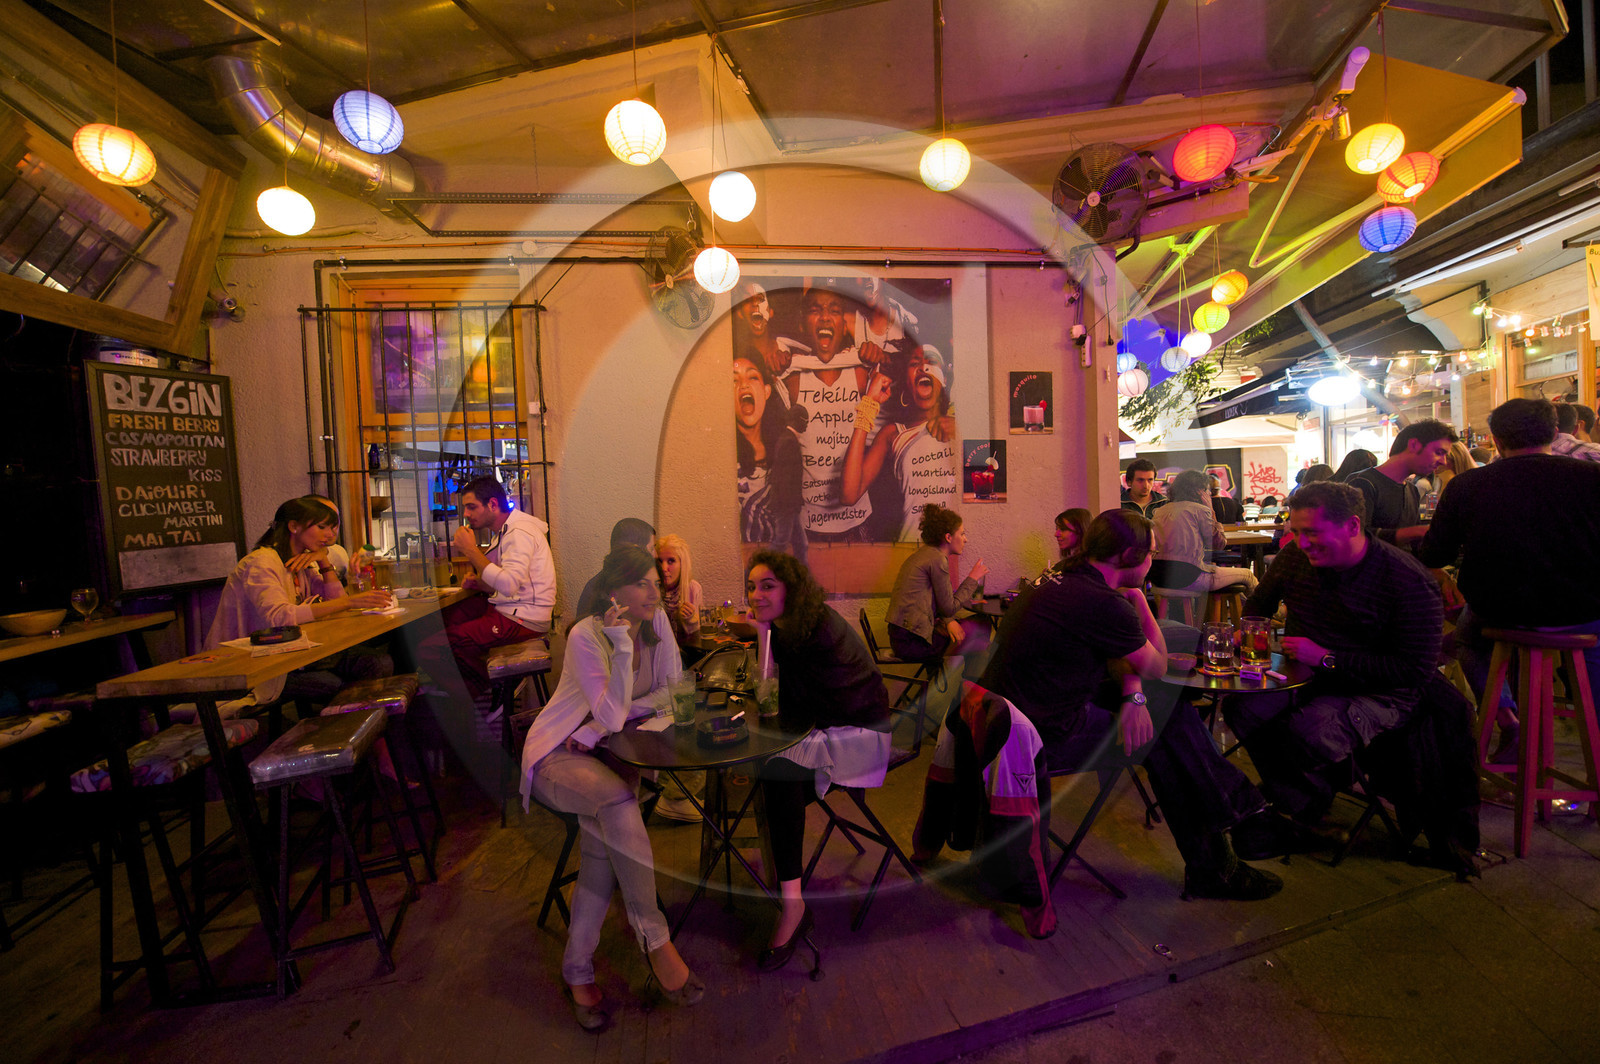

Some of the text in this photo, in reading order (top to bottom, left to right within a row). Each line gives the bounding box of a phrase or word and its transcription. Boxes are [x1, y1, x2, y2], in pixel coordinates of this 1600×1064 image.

[799, 387, 859, 404] Tekila
[108, 413, 220, 433] FRESH BERRY
[810, 409, 854, 429] Apple
[105, 432, 225, 449] COSMOPOLITAN
[816, 431, 850, 450] mojito
[110, 448, 207, 467] STRAWBERRY
[802, 454, 841, 467] Beer
[911, 447, 955, 465] coctail
[911, 467, 957, 478] martini
[806, 492, 832, 503] votk
[908, 484, 957, 498] longisland
[118, 500, 216, 517] CUCUMBER
[163, 514, 223, 529] MARTINI
[803, 507, 867, 528] jagermeister
